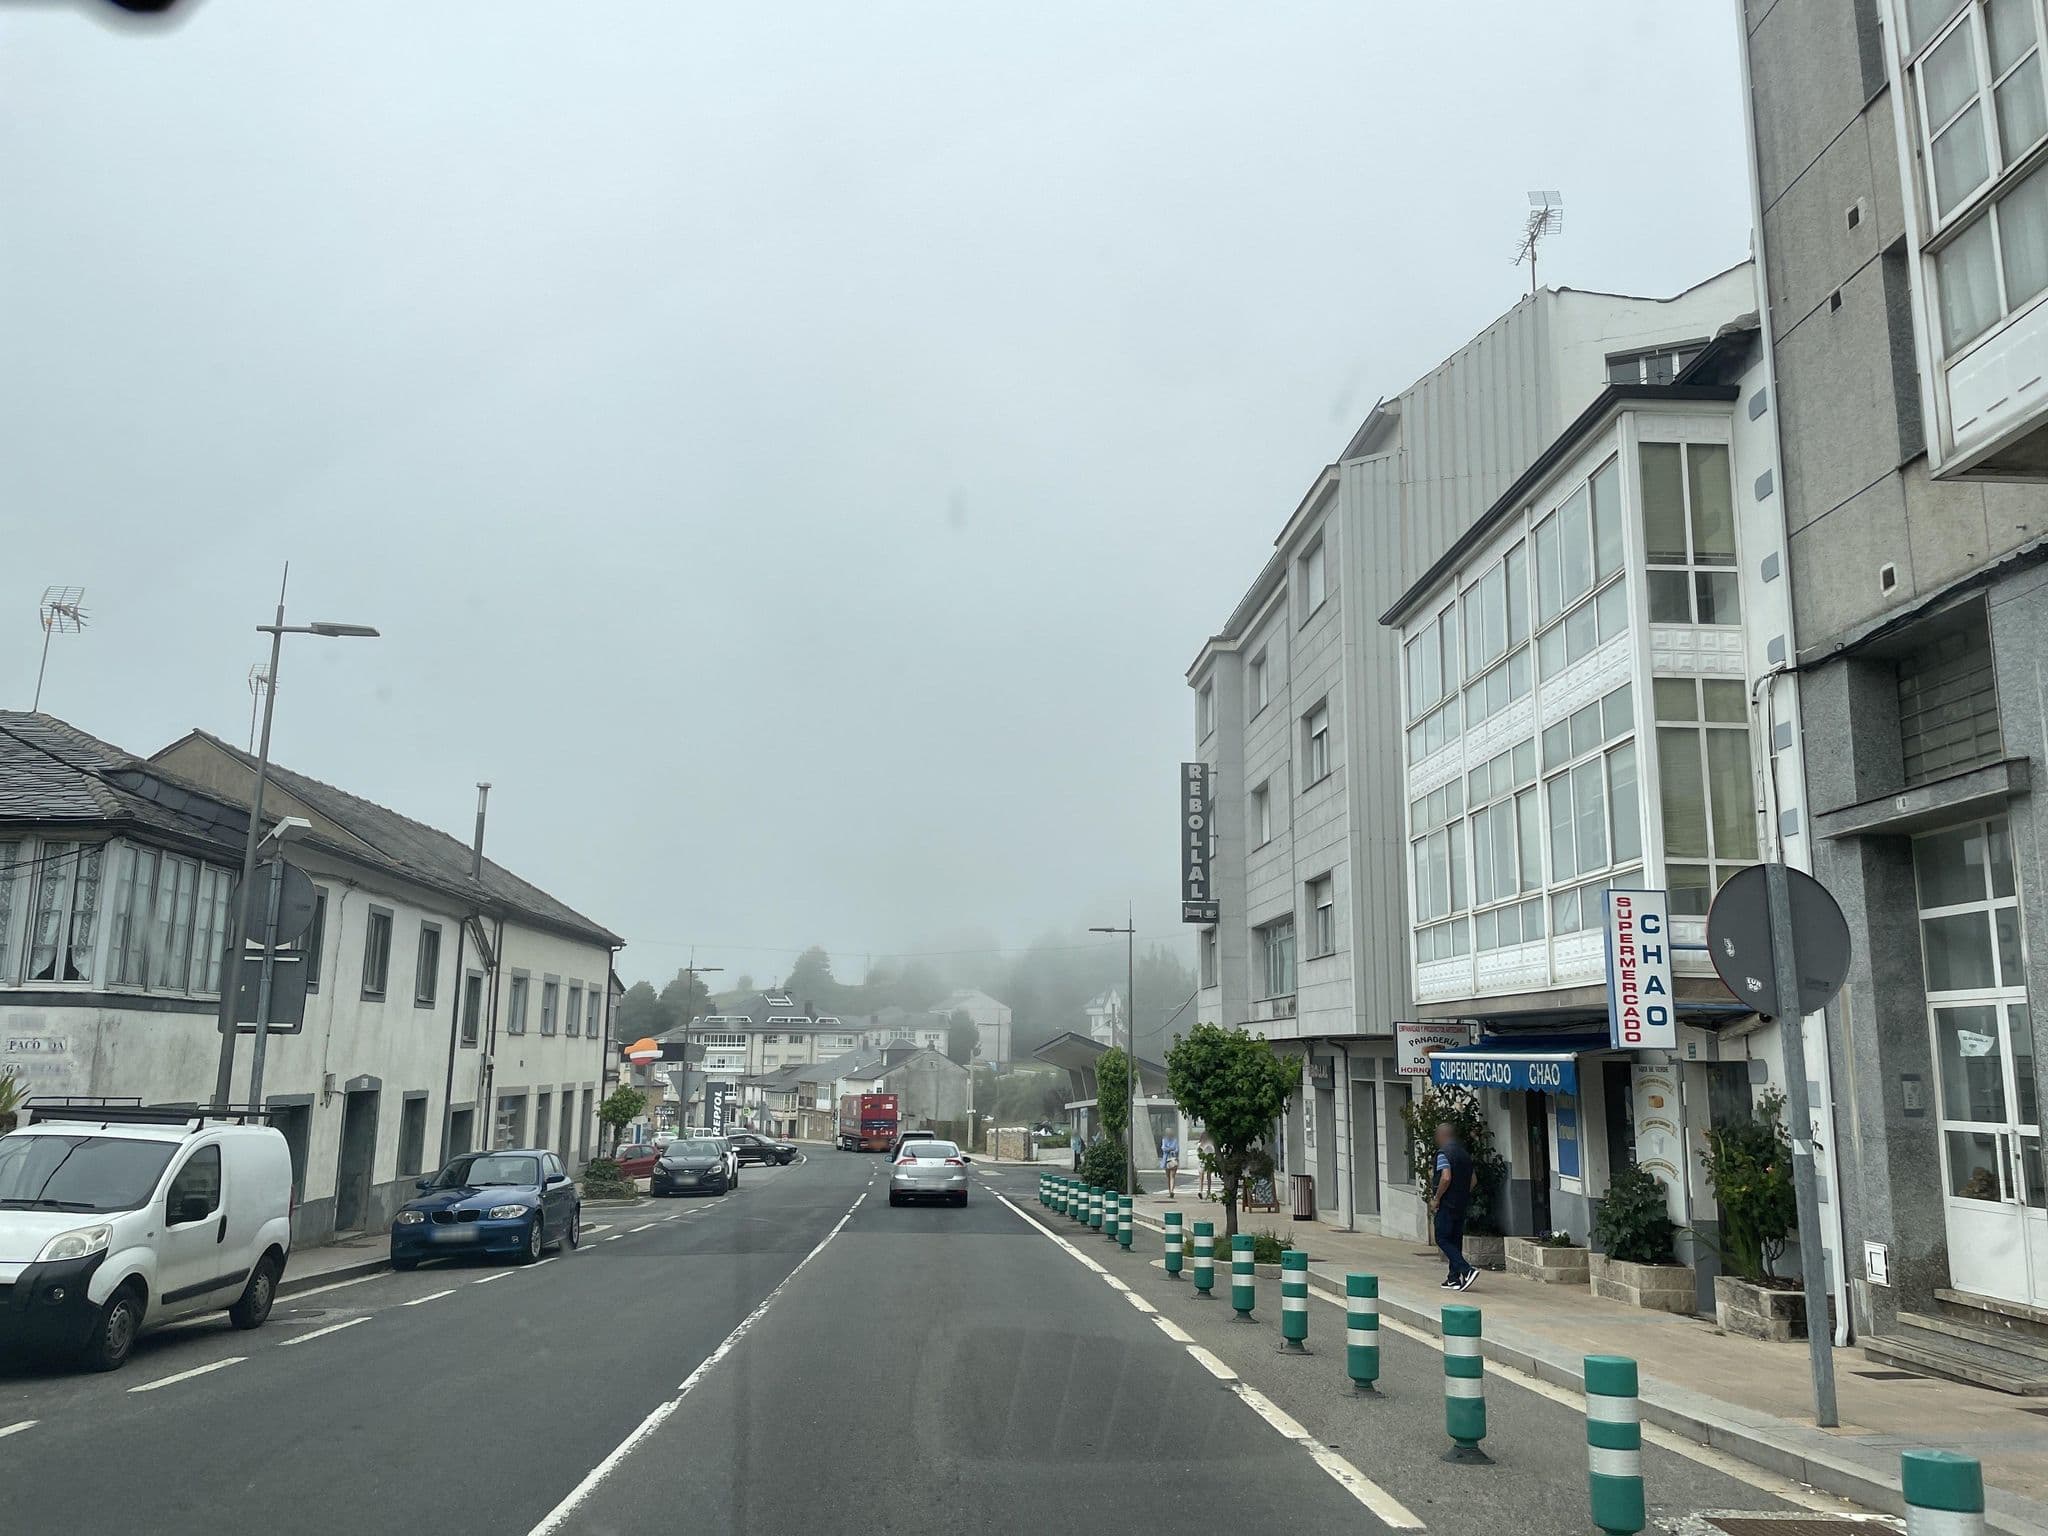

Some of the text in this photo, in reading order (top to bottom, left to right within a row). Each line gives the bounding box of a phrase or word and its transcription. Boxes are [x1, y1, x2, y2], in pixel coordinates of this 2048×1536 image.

[1188, 764, 1204, 899] REBOLLAL
[1617, 896, 1641, 1042] SUPERMERCADO
[1640, 914, 1668, 1026] CHAO
[712, 1090, 722, 1136] REPSOL
[1440, 1062, 1560, 1086] SUPERMERCADO CHAO
